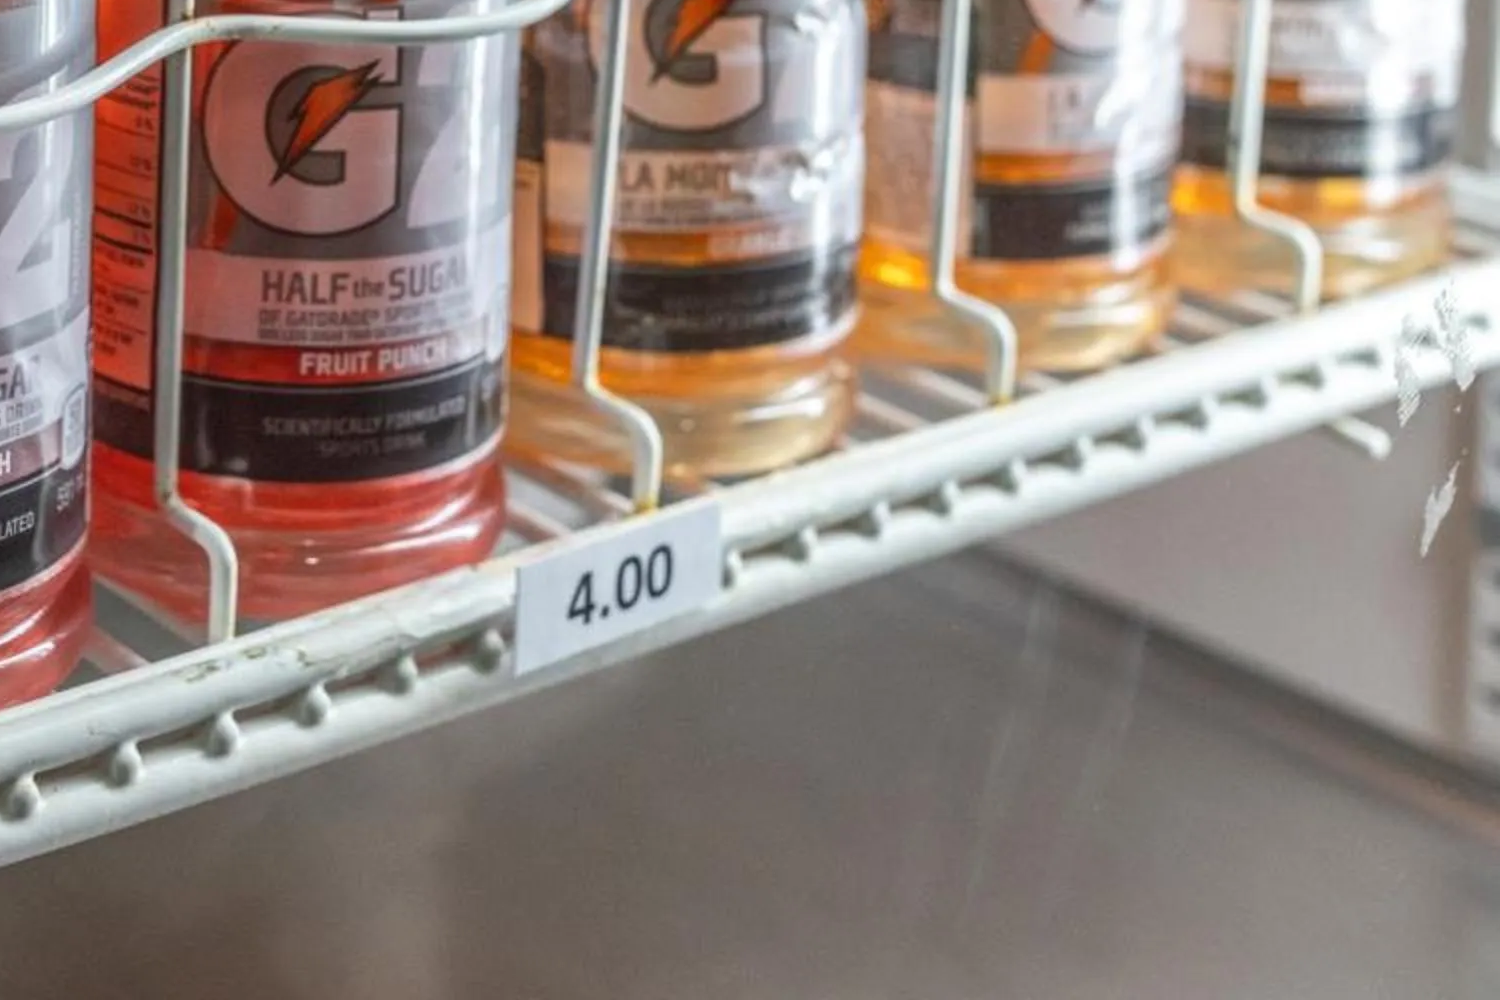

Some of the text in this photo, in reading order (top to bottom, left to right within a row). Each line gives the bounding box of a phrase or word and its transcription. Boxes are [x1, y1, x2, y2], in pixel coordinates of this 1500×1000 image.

[262, 269, 350, 305] HALF
[353, 276, 386, 300] the
[300, 350, 373, 377] FRUIT
[566, 543, 675, 626] 4.00
